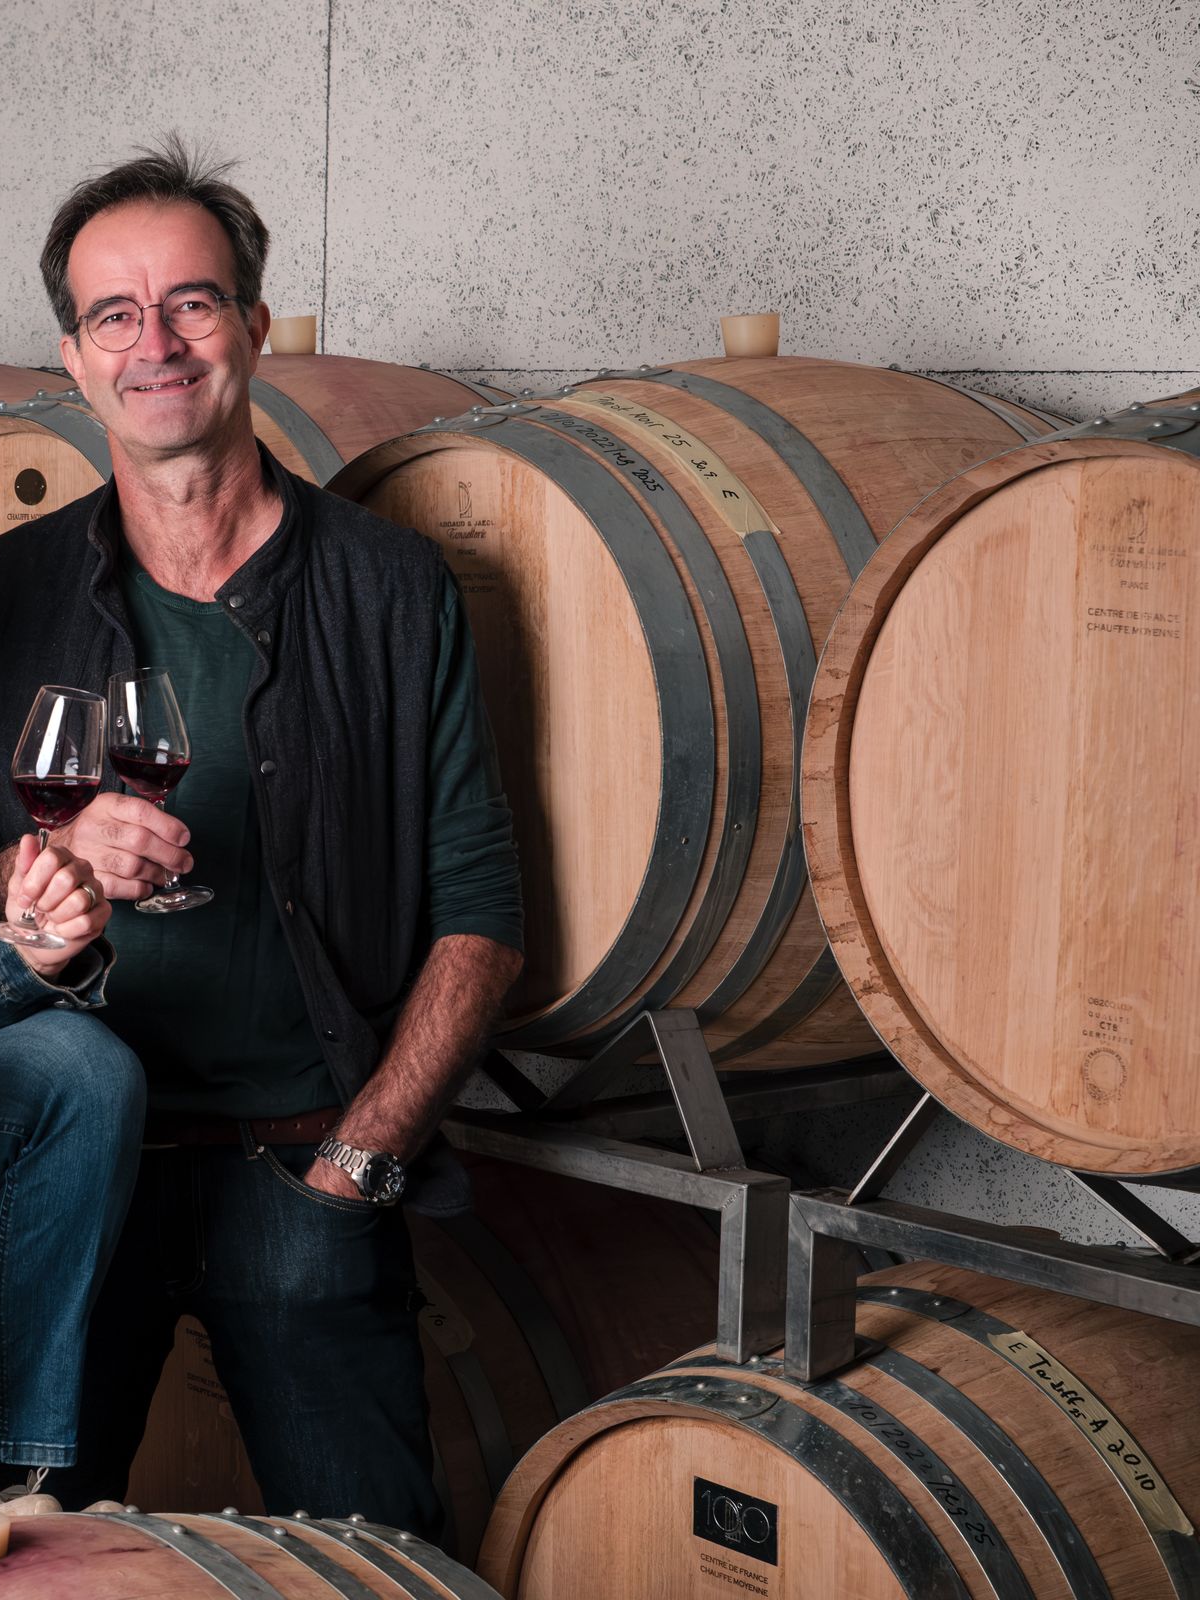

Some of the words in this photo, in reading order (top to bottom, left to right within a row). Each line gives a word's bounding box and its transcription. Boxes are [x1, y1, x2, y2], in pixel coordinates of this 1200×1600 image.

[662, 434, 692, 447] 25
[722, 490, 739, 499] E
[1086, 622, 1130, 635] CHAUFFE
[1087, 607, 1124, 619] CENTRE
[1126, 610, 1139, 620] DE
[1008, 1342, 1028, 1353] E
[1089, 1419, 1109, 1433] A
[1107, 1439, 1156, 1491] 20.10
[965, 1521, 995, 1547] 25
[700, 1553, 728, 1569] CENTRE
[728, 1563, 738, 1573] DE
[739, 1567, 769, 1584] FRANCE
[700, 1565, 732, 1584] CHAUFFE
[733, 1578, 769, 1597] MOYENNE
